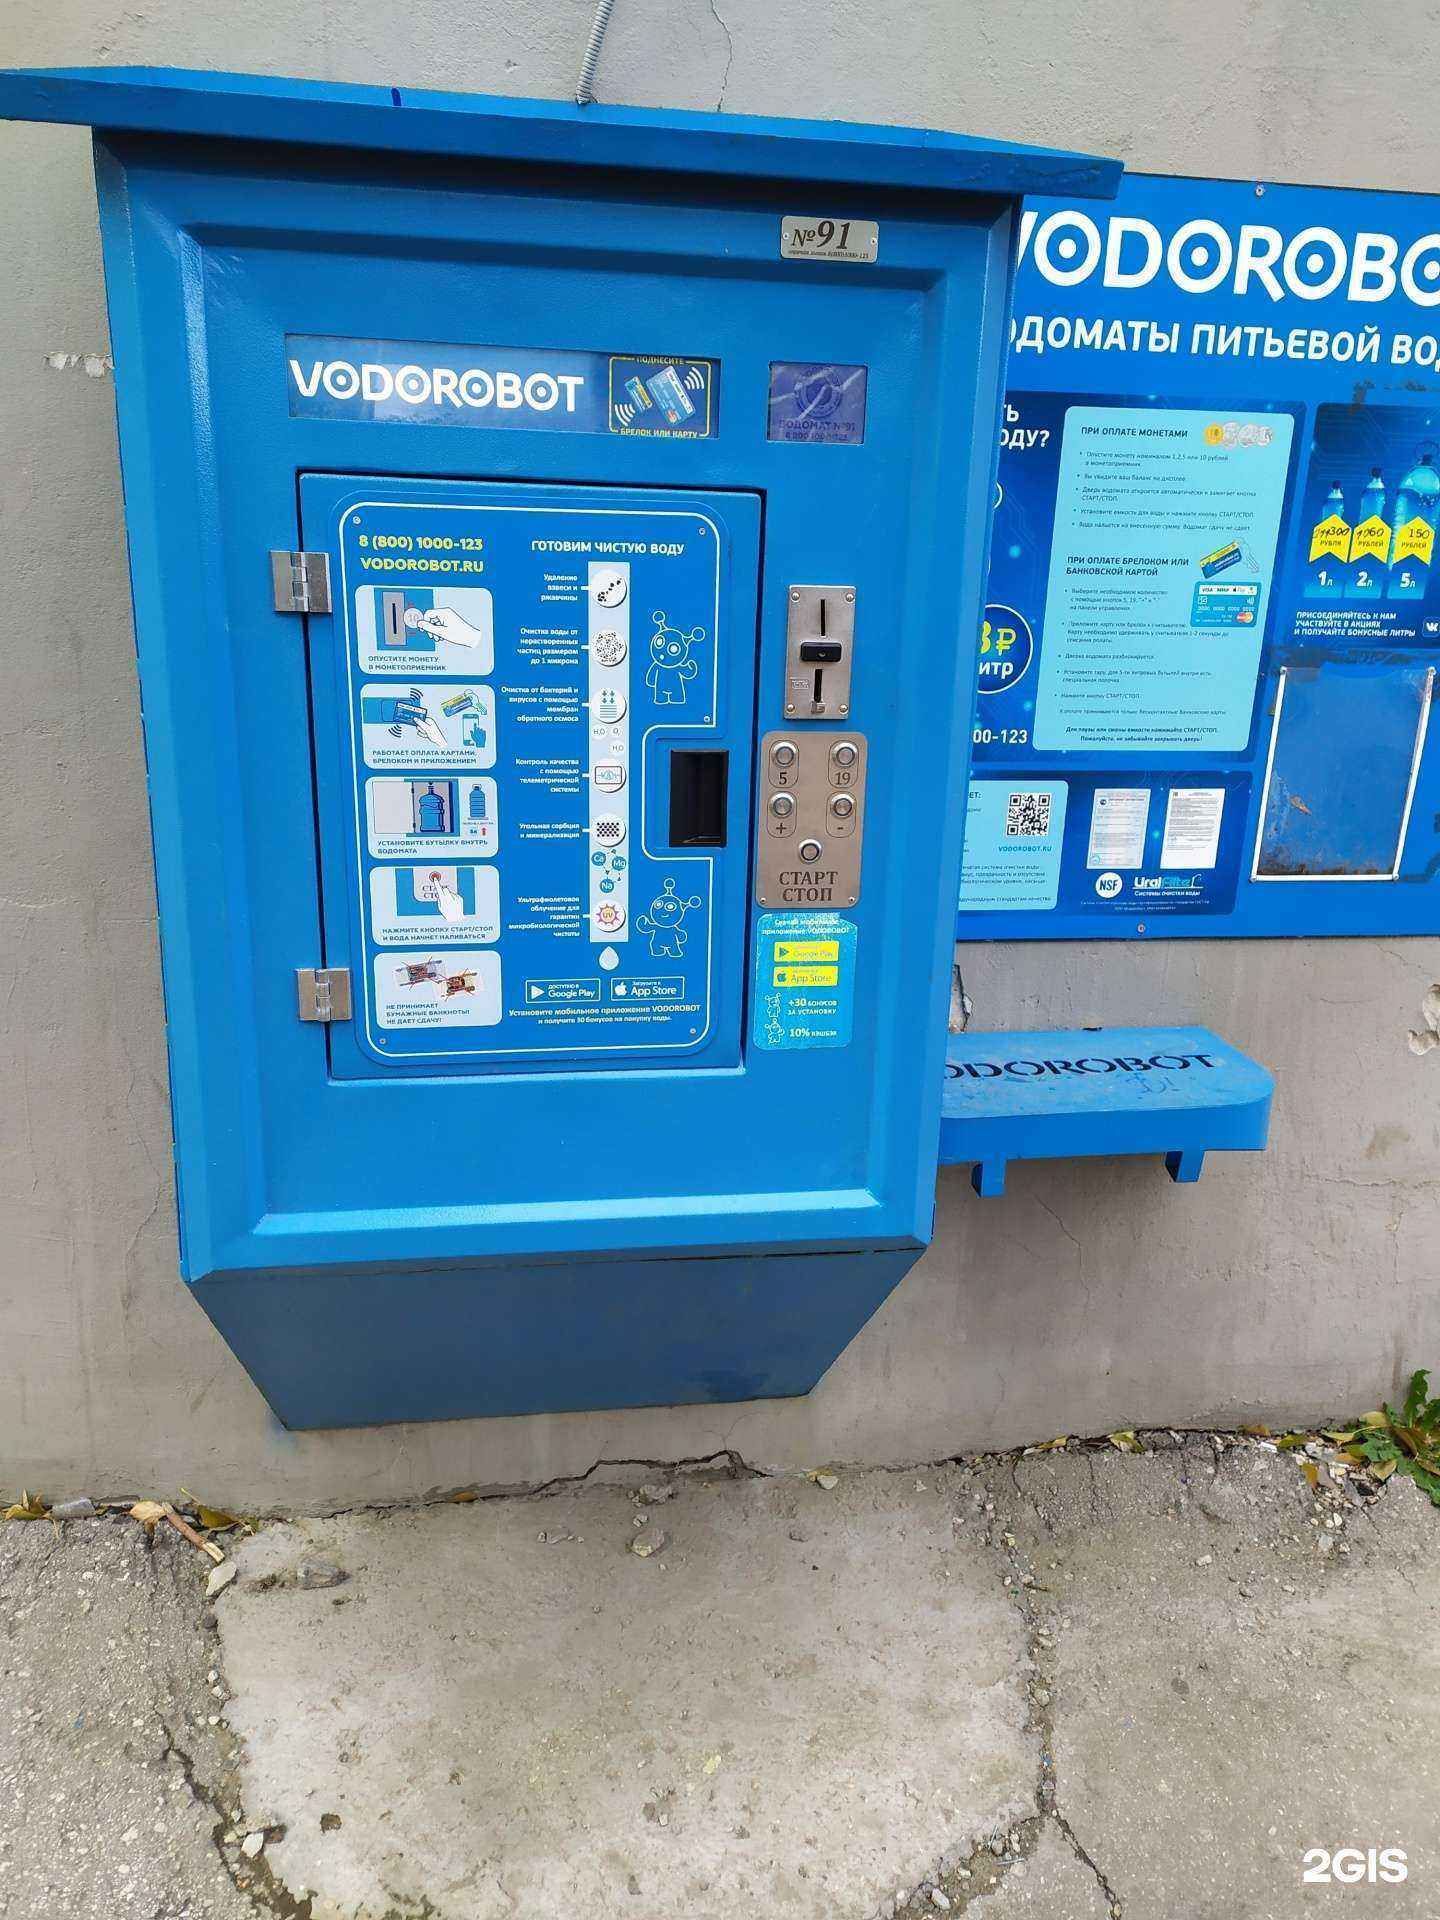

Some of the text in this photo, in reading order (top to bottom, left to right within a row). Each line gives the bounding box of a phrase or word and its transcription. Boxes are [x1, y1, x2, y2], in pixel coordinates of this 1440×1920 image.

[1009, 314, 1440, 372] ДОМАТЫ ПИТЬЕВОЙ ВО
[636, 355, 685, 366] ПОДНЕСИТЕ
[289, 359, 584, 413] VODOROBOT
[1004, 404, 1020, 422] Ь
[620, 427, 698, 439] БРЕЛОК ИЛИ КАРТУ
[1081, 426, 1188, 438] ПРИ ОПЛАТЕ МОНЕТАМИ
[358, 534, 484, 551] 8 (800) 1000-123
[531, 540, 685, 556] ГОТОВИМ ЧИСТУЮ ВОДУ
[360, 557, 484, 573] VODOROBOT.RU
[1067, 556, 1190, 567] ПРИ ОПЛАТЕ БРЕЛОКОМ ИЛИ
[1066, 566, 1158, 577] БАНКОВСКОЙ КАРТОЙ
[543, 573, 578, 583] Удаление
[540, 594, 578, 602] ржавчины
[1296, 611, 1372, 620] ПРИСОЕДИНЯЙТЕСЬ
[1295, 619, 1343, 628] УЧАСТВУЙТЕ
[1350, 621, 1381, 629] АКЦИЯХ
[520, 627, 549, 636] Очистка
[551, 628, 569, 637] воды
[1301, 627, 1346, 636] ПОЛУЧАЙТЕ
[1347, 629, 1388, 637] БОНУСНЫЕ
[1389, 629, 1416, 637] ЛИТРЫ
[520, 637, 578, 647] нерастворенных
[516, 647, 578, 657] частиц размером
[368, 655, 407, 663] ОПУСТИТЕ
[530, 658, 540, 666] до
[501, 686, 530, 695] Очистка
[540, 686, 572, 696] бактерий
[543, 696, 579, 704] помощью
[517, 714, 552, 723] обратного
[372, 749, 409, 757] РАБОТАЕТ
[372, 757, 413, 765] БРЕЛОКОМ
[515, 758, 579, 767] Контроль качества
[544, 768, 580, 776] помощью
[778, 771, 788, 785] 5
[835, 771, 851, 786] 19
[550, 786, 579, 794] системы
[377, 839, 488, 847] УСТАНОВИТЕ БУТЫЛКУ ВНУТРЬ
[377, 848, 418, 856] ВОДОМАТА
[778, 870, 839, 886] СТАРТ
[1099, 879, 1118, 891] NSF
[782, 887, 832, 902] СТОП
[382, 927, 419, 935] НАЖМИТЕ
[420, 926, 449, 934] КНОПКУ
[439, 933, 486, 941] НАЛИВАТЬСЯ
[548, 988, 595, 999] Google Play
[630, 985, 678, 997] App Store
[508, 1004, 701, 1018] Установите мобильное приложение VODOROBOT
[789, 1028, 810, 1038] 10%
